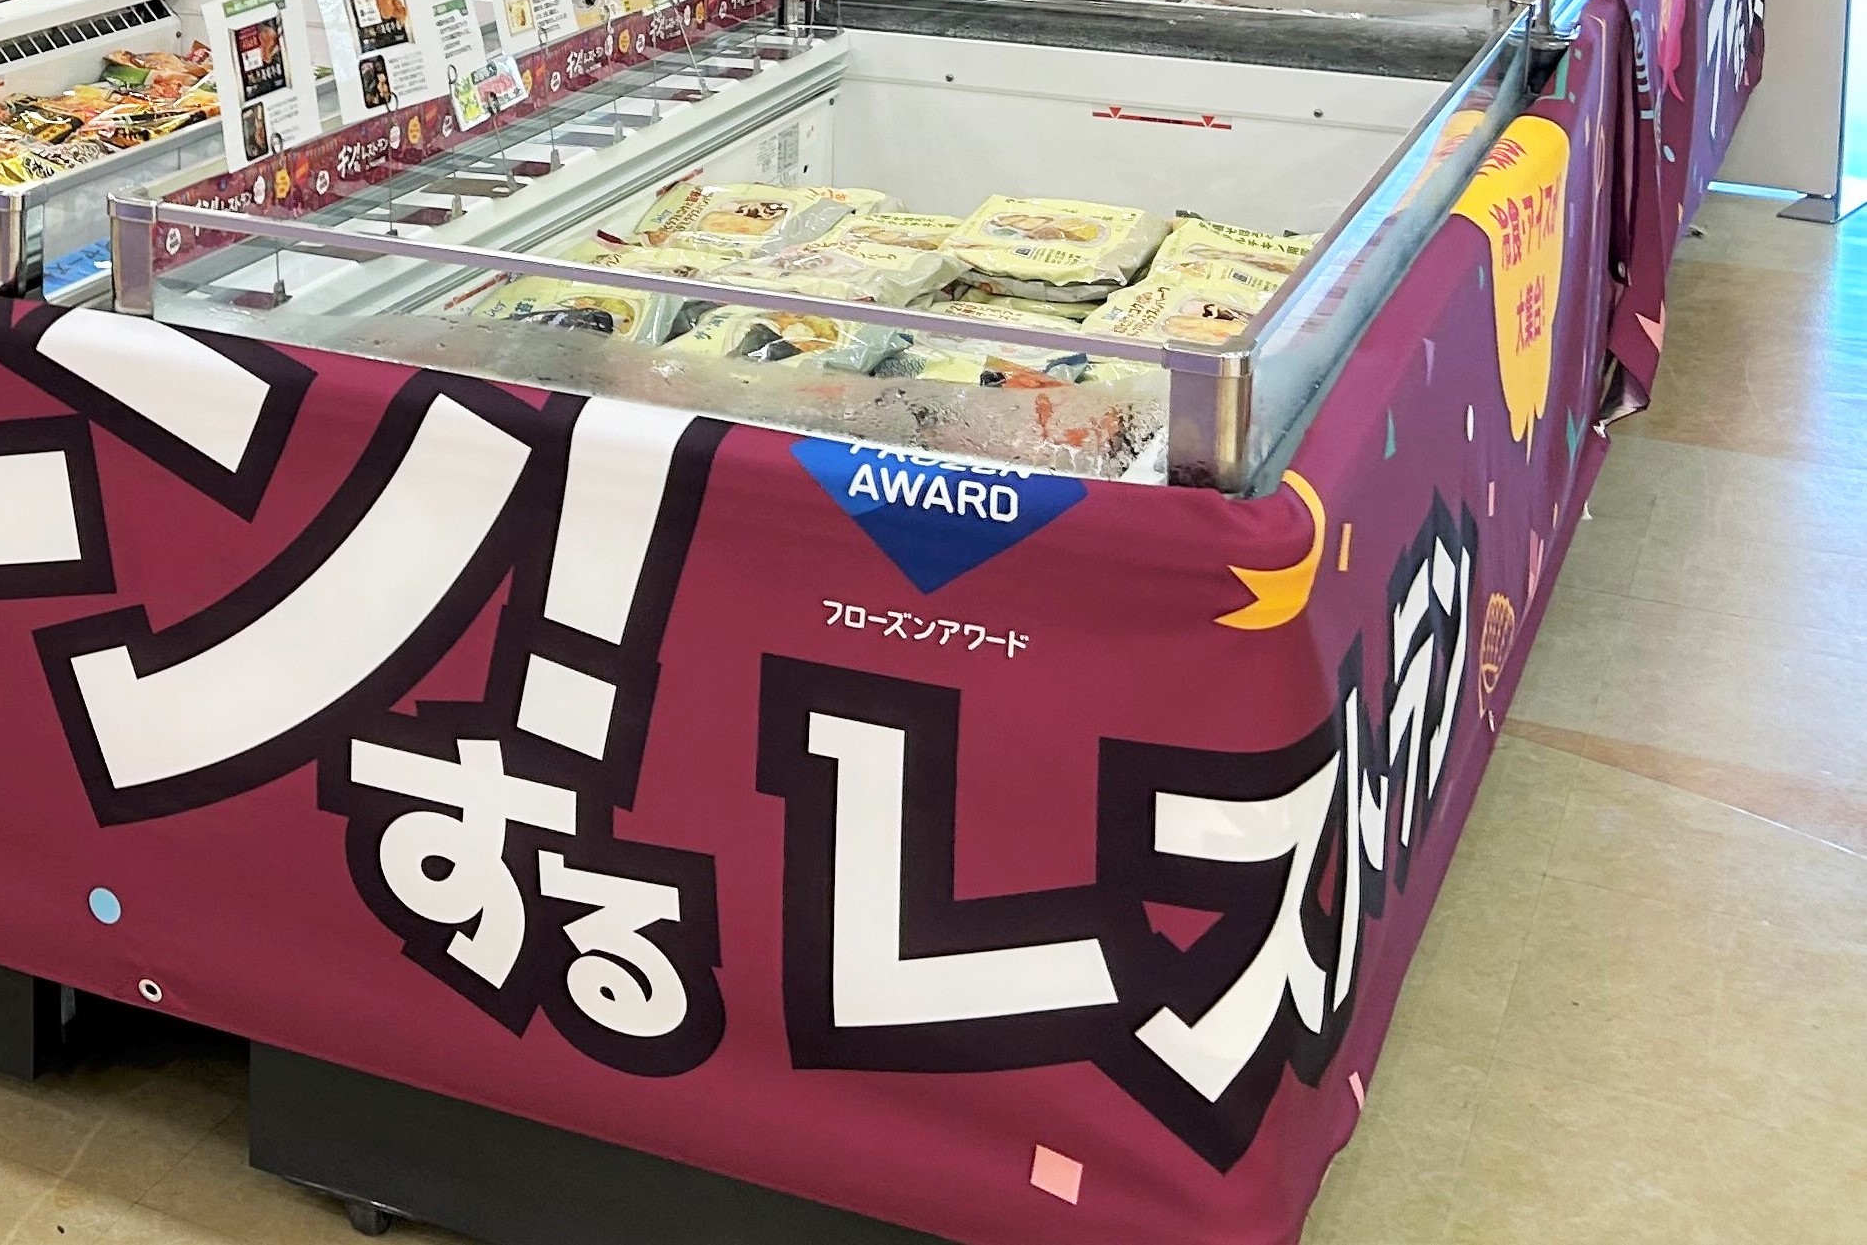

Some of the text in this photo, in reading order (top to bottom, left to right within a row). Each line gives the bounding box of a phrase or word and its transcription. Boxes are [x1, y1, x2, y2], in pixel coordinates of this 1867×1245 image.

[848, 463, 1020, 523] AWARD
[822, 599, 1030, 659] フローズンアワード
[347, 736, 690, 1039] する
[808, 536, 1471, 1104] レストラン
